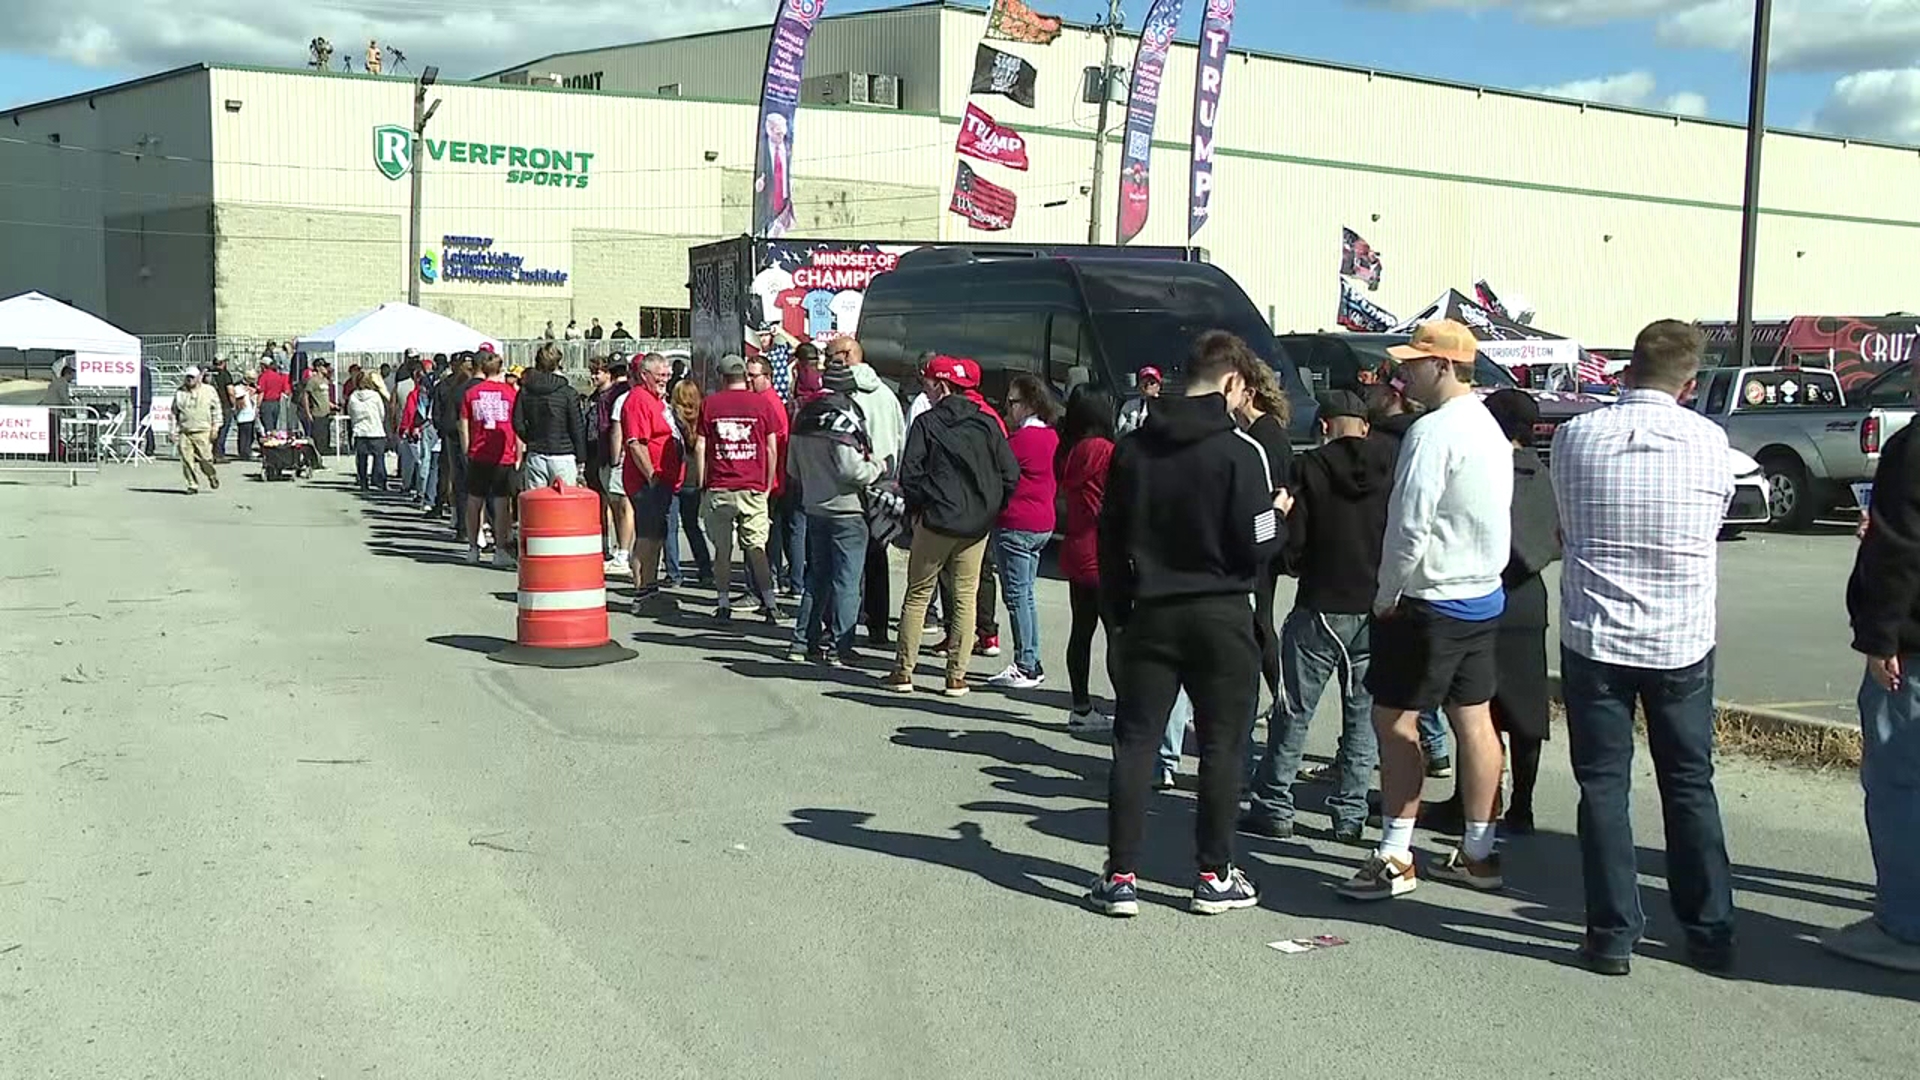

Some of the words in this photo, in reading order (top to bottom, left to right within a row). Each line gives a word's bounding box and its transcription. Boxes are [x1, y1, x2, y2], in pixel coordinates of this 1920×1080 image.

[1193, 29, 1226, 197] TRUMP
[966, 113, 1022, 152] TRUMP
[506, 170, 589, 189] SPORTS
[443, 250, 486, 266] Lehigh
[813, 254, 872, 266] MINDSET
[875, 255, 896, 266] OF
[518, 269, 568, 287] Institute
[80, 360, 136, 374] PRESS
